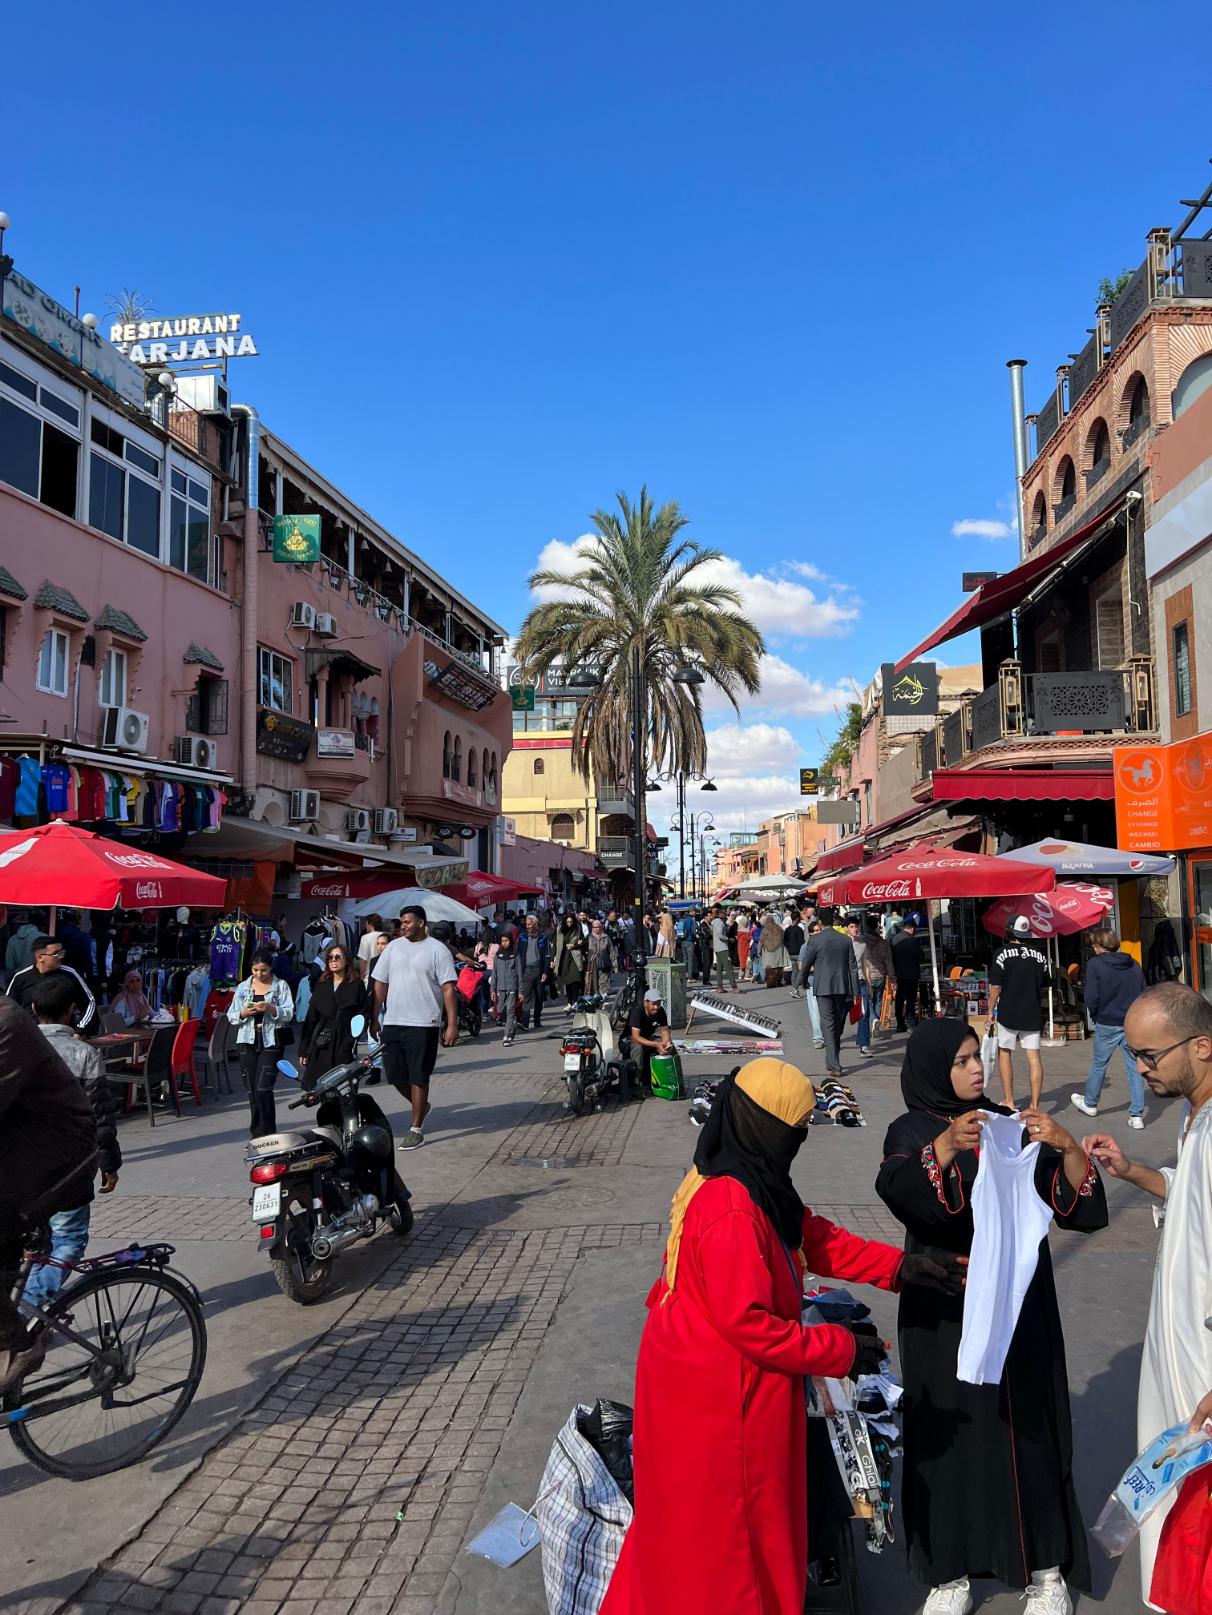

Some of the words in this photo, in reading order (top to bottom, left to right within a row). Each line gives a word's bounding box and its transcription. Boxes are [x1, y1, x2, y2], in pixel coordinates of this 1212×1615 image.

[110, 314, 241, 342] RESTAURANT
[1127, 798, 1159, 807] الصرف
[897, 857, 979, 871] Coca-Cola
[311, 883, 344, 896] Coca-Cola
[862, 879, 912, 899] Coca-Cola
[253, 1140, 279, 1150] DOCKER
[1124, 1474, 1146, 1494] REEF
